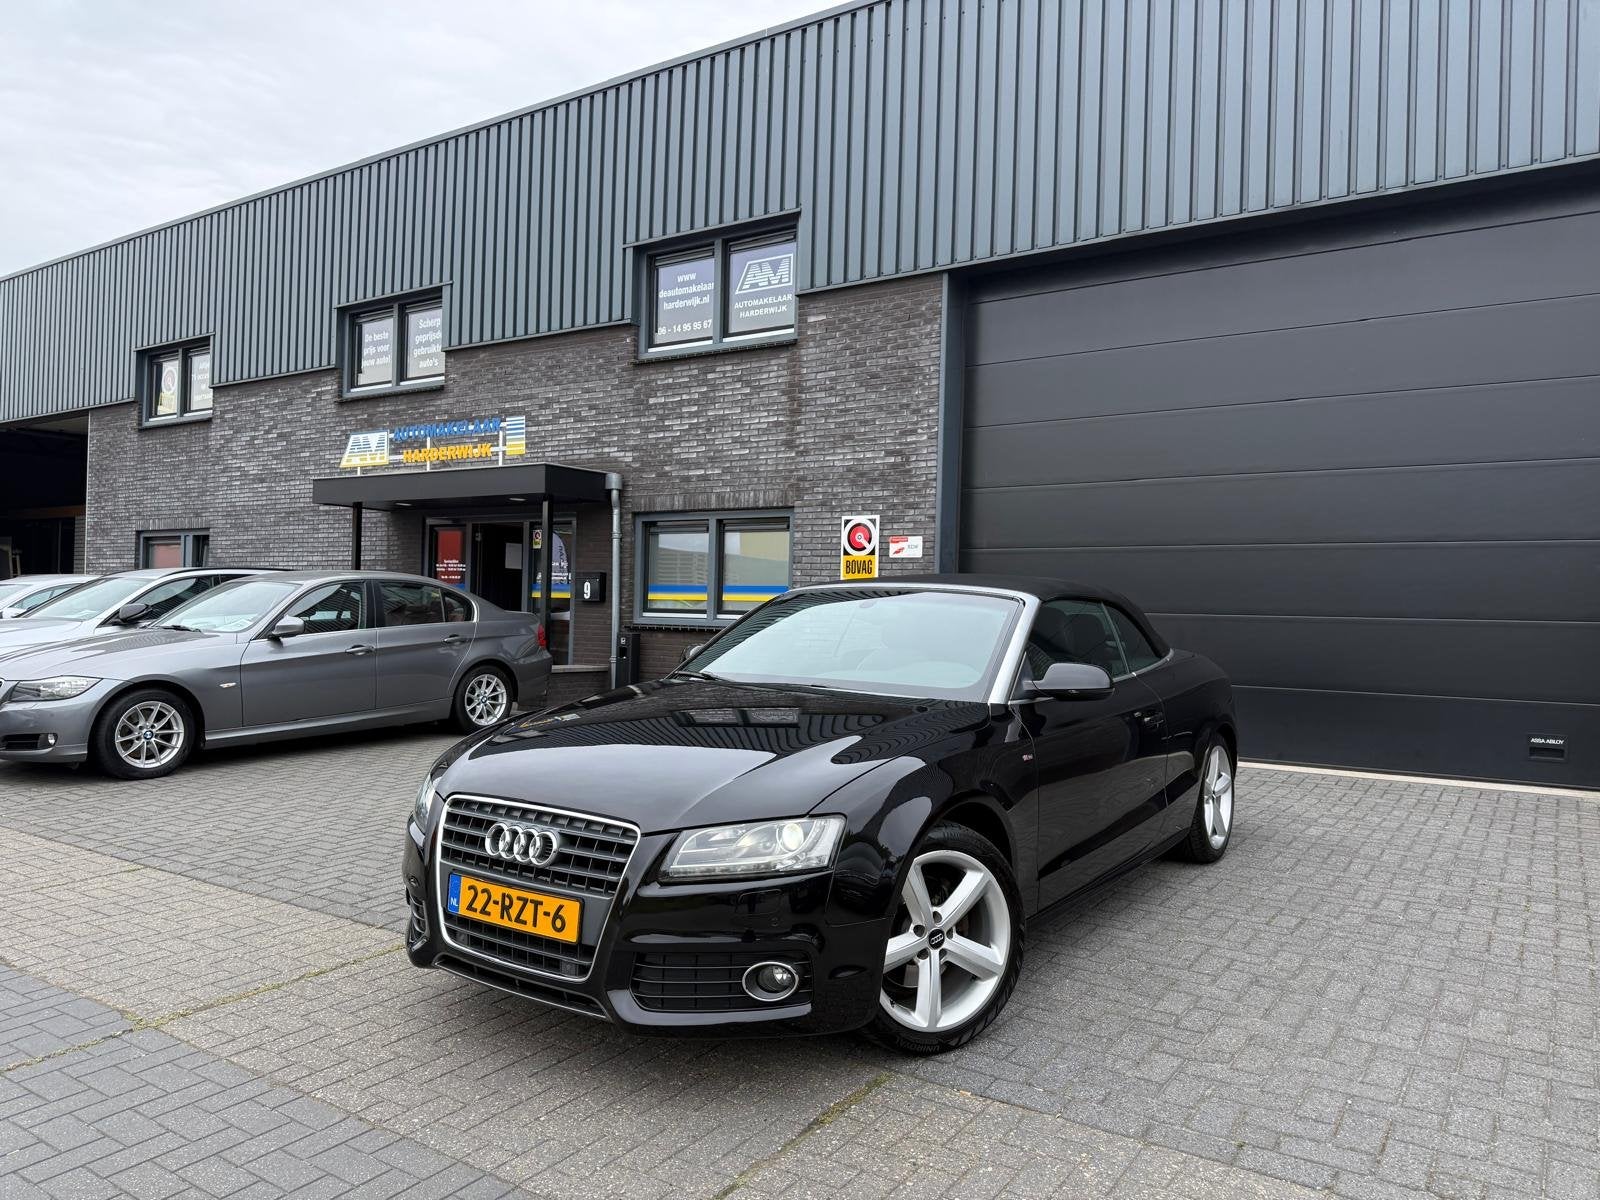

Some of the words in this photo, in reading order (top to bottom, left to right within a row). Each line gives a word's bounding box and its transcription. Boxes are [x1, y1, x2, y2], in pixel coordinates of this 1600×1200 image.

[677, 272, 697, 282] www
[742, 258, 790, 290] AM
[663, 295, 710, 311] harderwijk.nl
[734, 293, 793, 309] AUTOMAKELAAR
[739, 305, 788, 319] HARDERWIJK
[673, 323, 681, 333] 14
[693, 321, 702, 330] 95
[703, 319, 713, 329] 67
[373, 331, 389, 341] beste
[363, 346, 376, 357] prijs
[377, 344, 390, 353] voor
[419, 358, 439, 369] auto's
[392, 417, 502, 442] AUTOMAKELAAR
[402, 443, 493, 463] HARDERWIJK
[845, 559, 873, 575] BOVAG
[583, 581, 591, 599] 9
[450, 897, 459, 907] NL
[465, 884, 567, 933] 22-RZT-6
